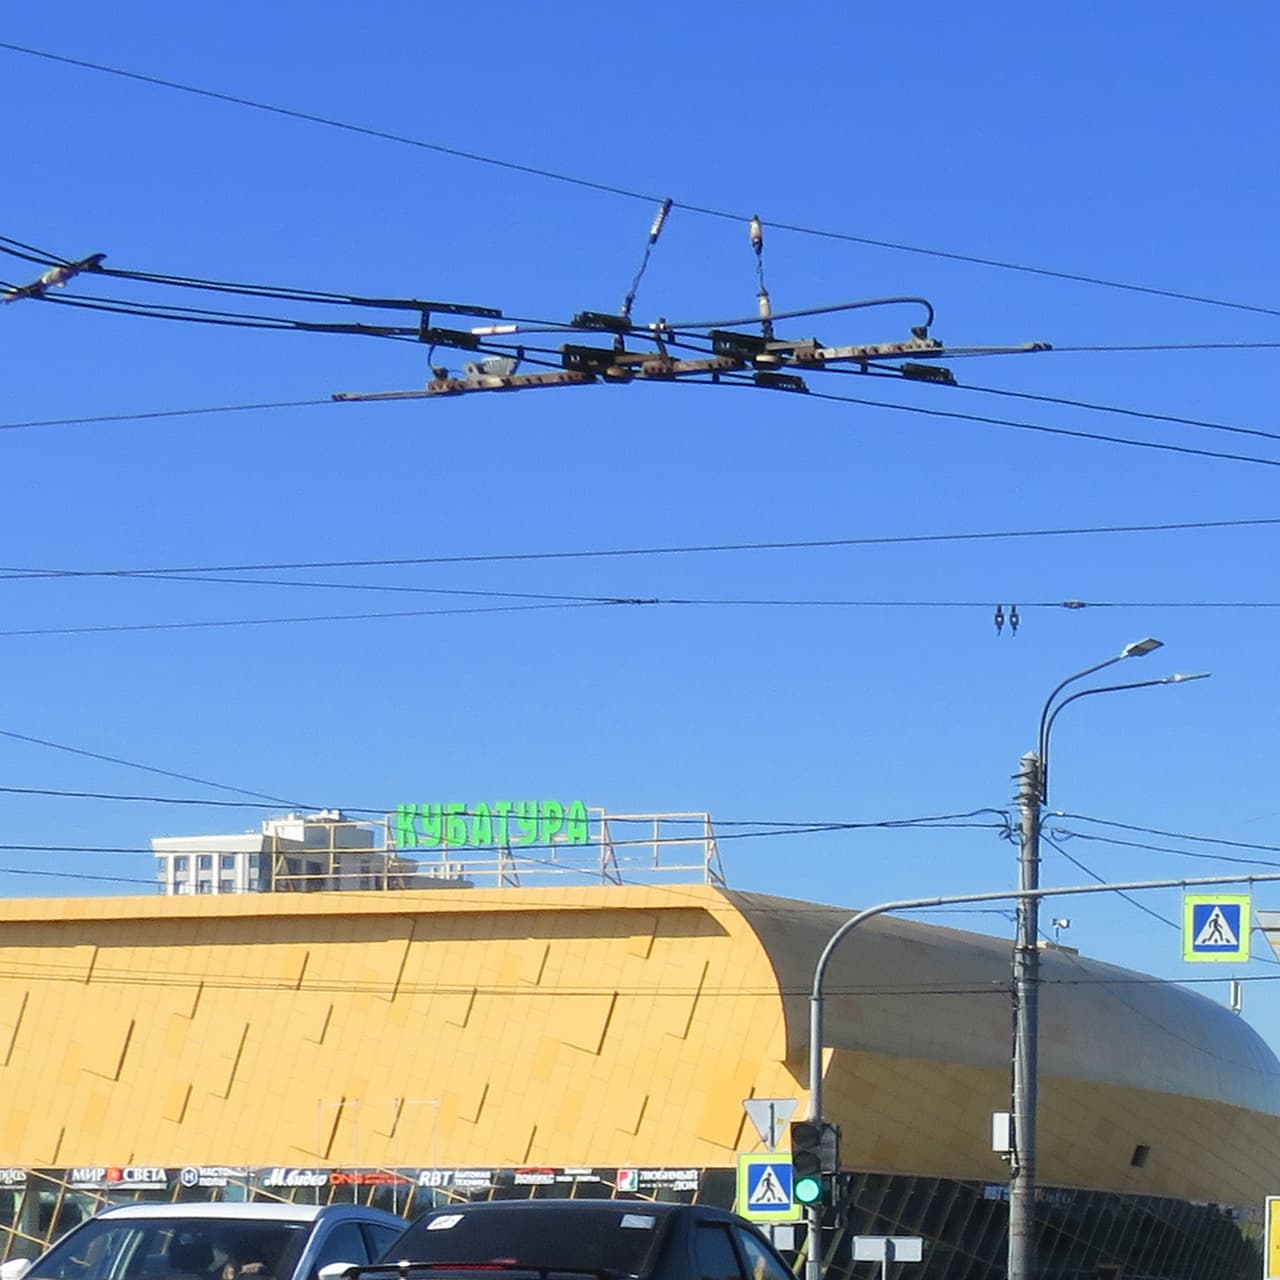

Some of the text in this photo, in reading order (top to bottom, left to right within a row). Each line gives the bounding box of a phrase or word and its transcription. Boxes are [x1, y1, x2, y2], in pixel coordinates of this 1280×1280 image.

[396, 800, 590, 848] КУБАТУРА
[72, 1168, 167, 1182] МИР СВЕТА
[419, 1170, 453, 1187] RBT
